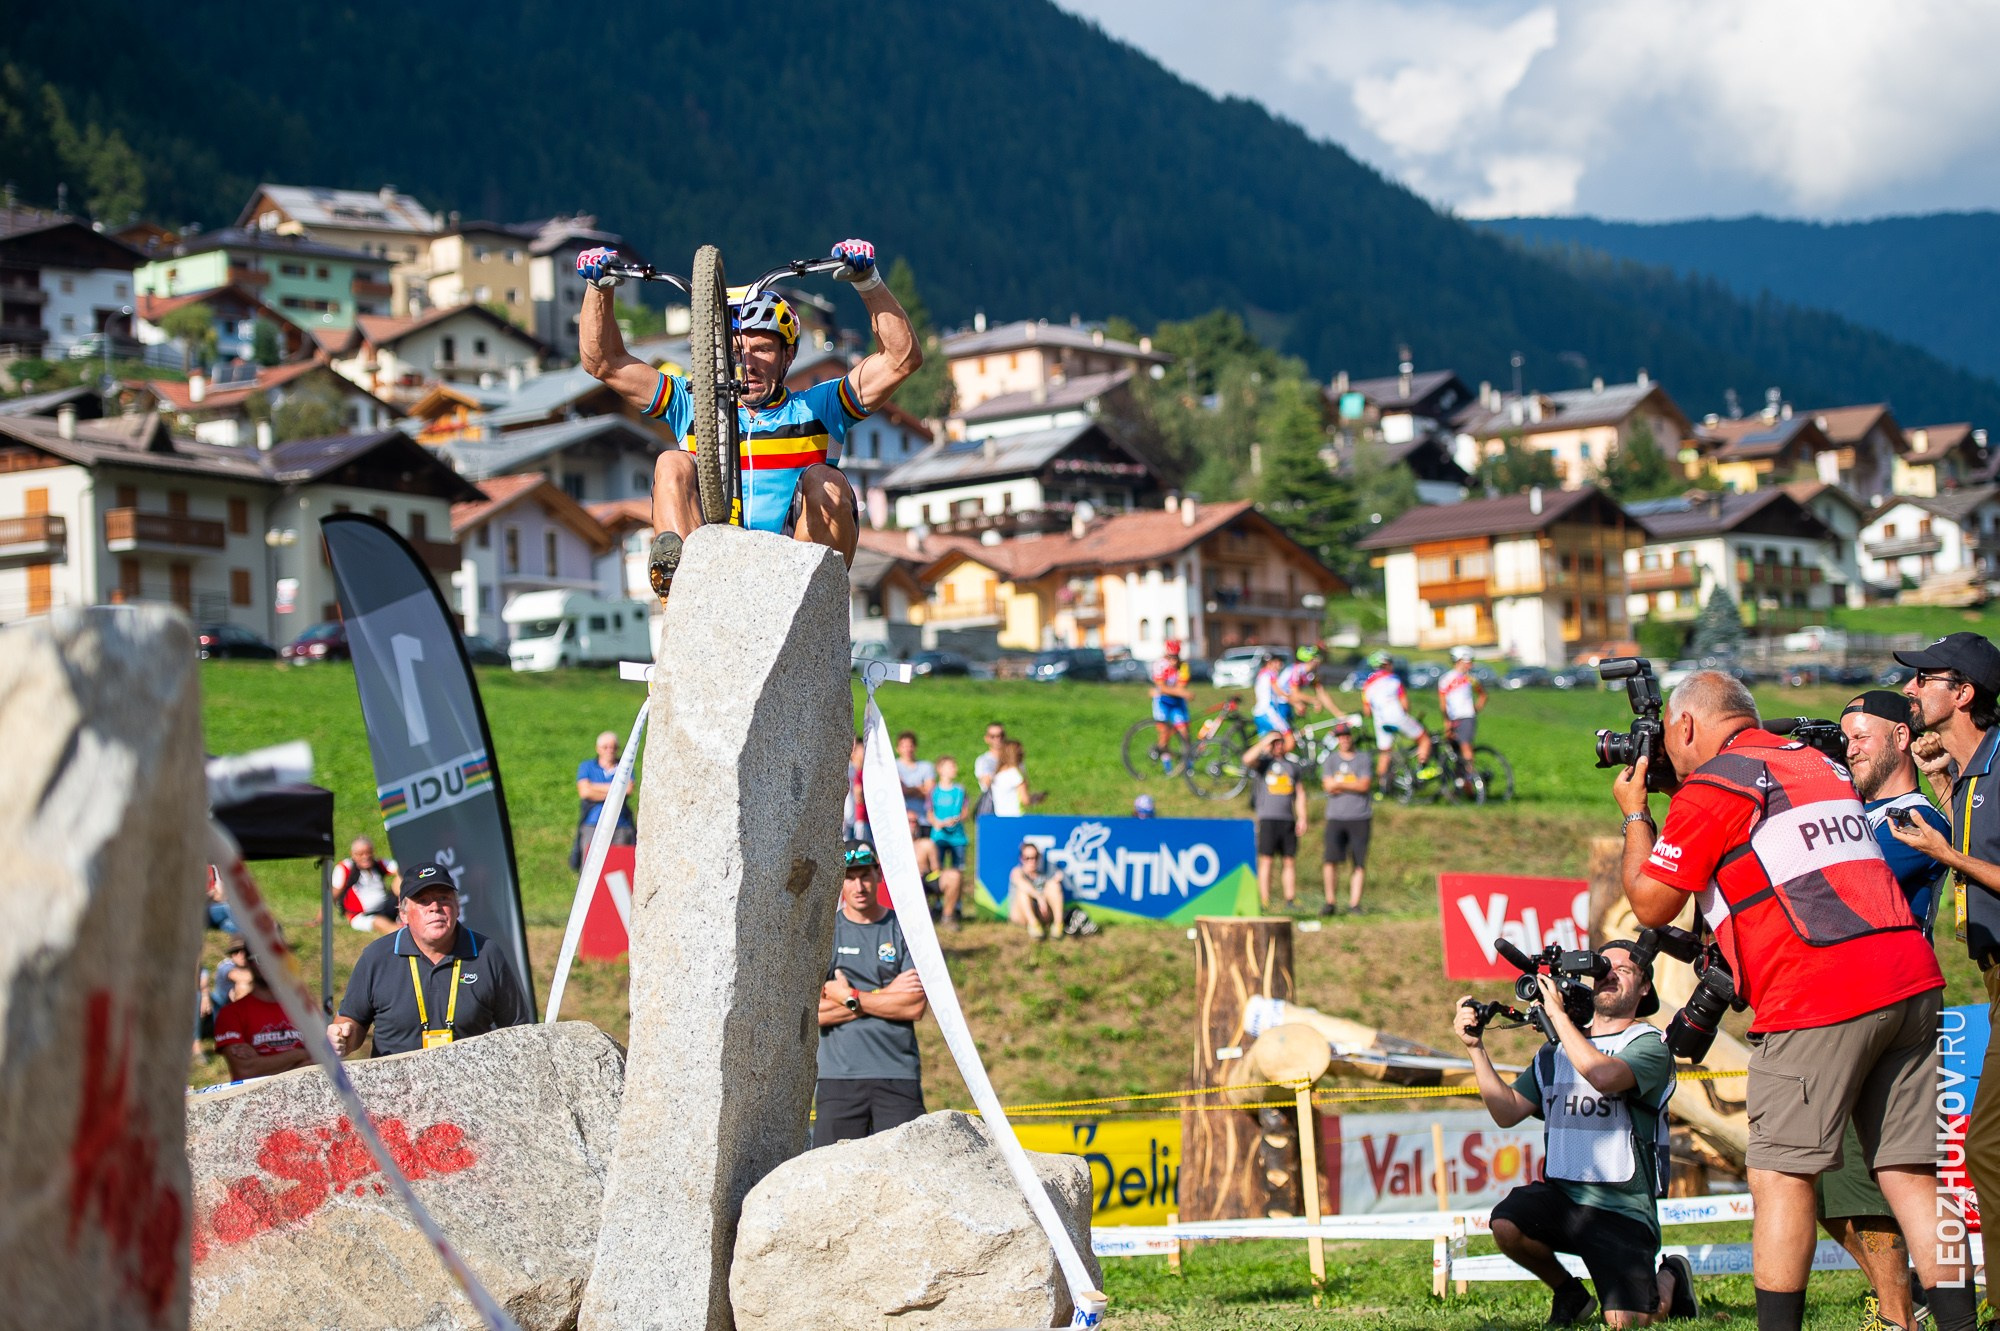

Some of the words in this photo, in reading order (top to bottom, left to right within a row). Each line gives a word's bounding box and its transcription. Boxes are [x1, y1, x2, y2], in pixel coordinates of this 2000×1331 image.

[1023, 834, 1221, 901] TRENTINO
[1457, 892, 1542, 966] Val
[253, 1029, 304, 1046] BIKELAN
[1564, 1094, 1622, 1118] HOST
[1084, 1138, 1181, 1210] Deli
[1361, 1132, 1423, 1198] Val
